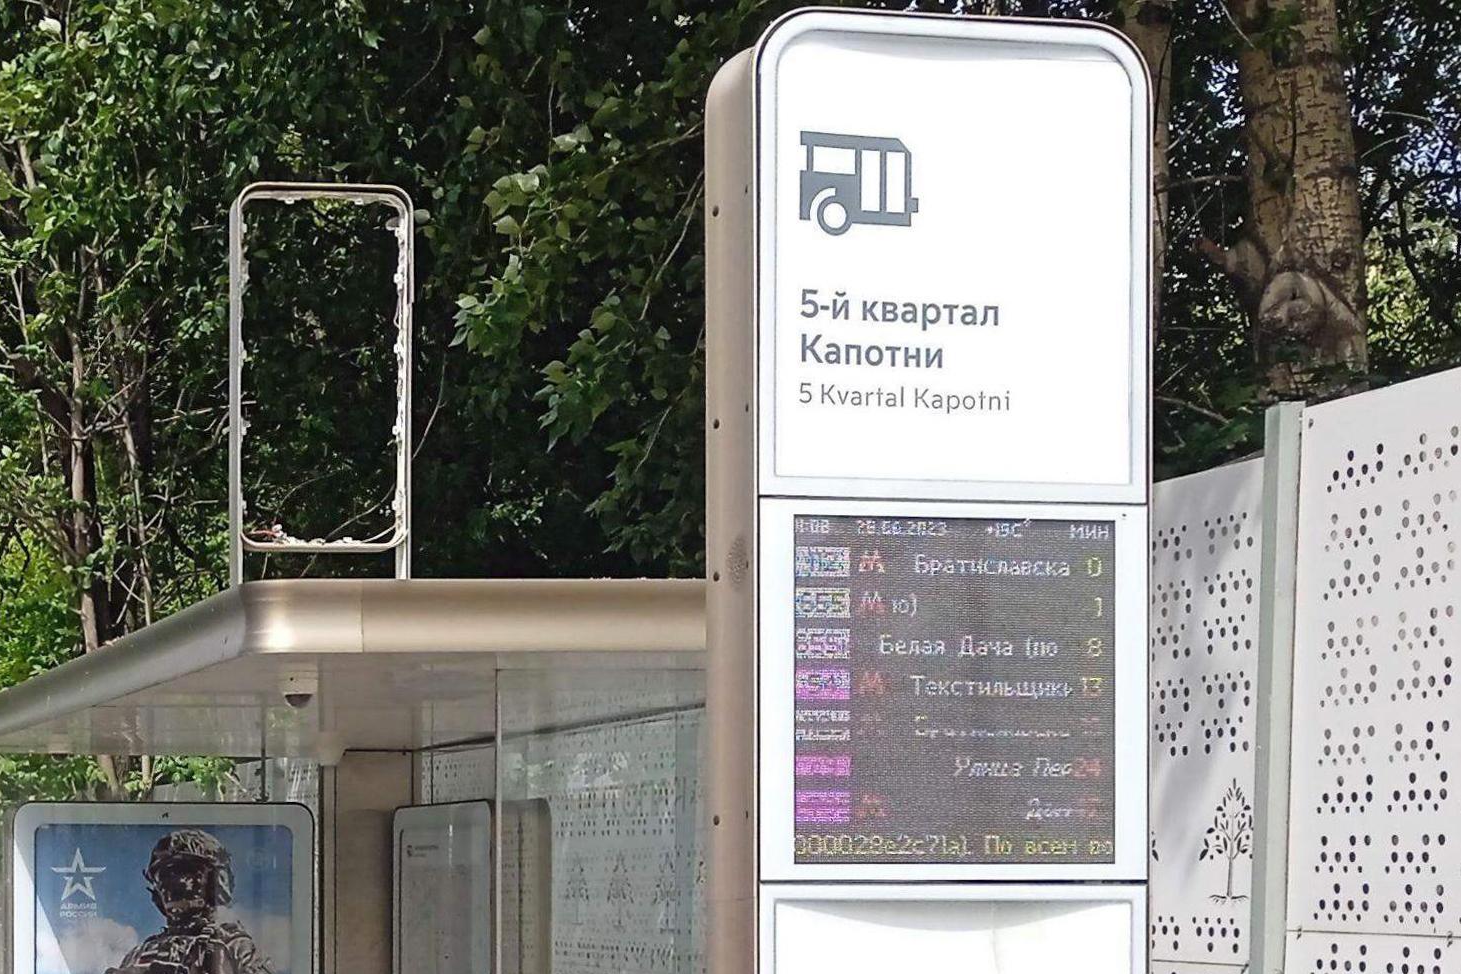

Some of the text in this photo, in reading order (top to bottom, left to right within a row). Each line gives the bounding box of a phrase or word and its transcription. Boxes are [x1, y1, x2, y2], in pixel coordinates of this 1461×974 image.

[800, 288, 1000, 332] 5-й квартал
[800, 333, 944, 369] Капотни
[798, 382, 1011, 415] 5 Kvartal Kapotni
[1086, 556, 1103, 577] 0
[1093, 596, 1103, 617] 1
[879, 634, 946, 656] Белая
[957, 635, 1014, 658] Дача
[1087, 637, 1103, 657] 8
